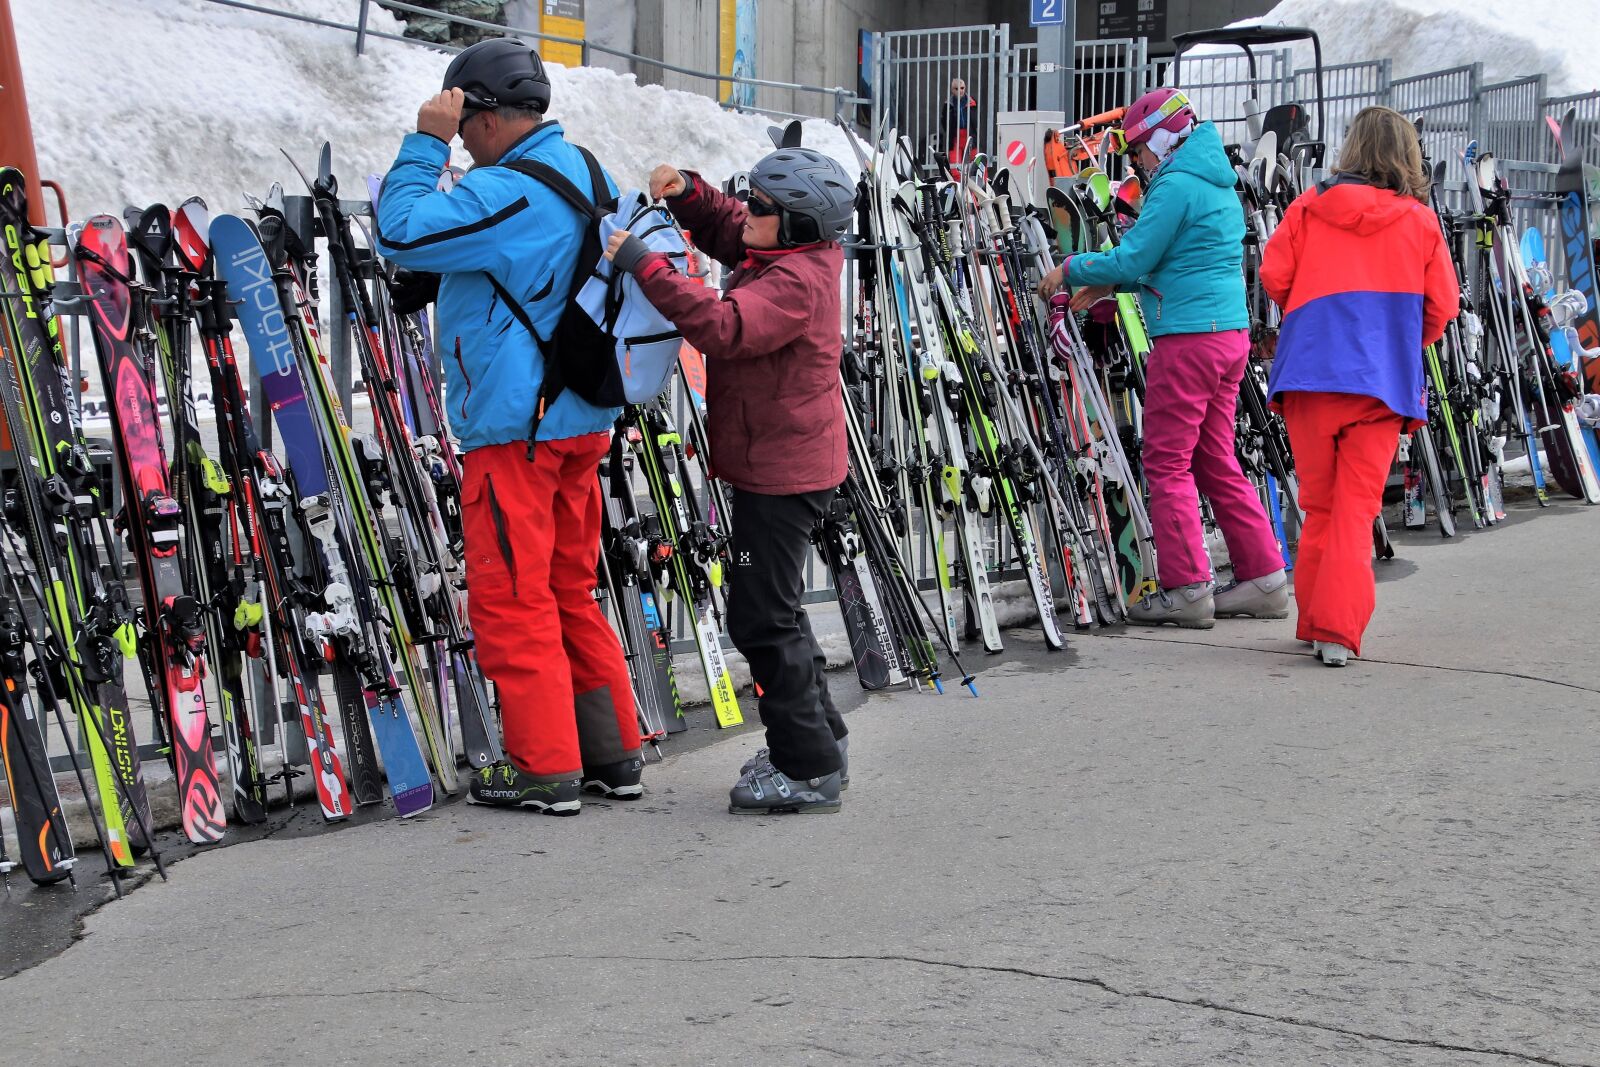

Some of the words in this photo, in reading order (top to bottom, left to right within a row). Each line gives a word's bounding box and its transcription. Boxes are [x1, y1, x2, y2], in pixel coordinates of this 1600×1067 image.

[1042, 0, 1056, 17] 2
[5, 224, 37, 319] HEAD
[231, 245, 296, 377] stöckli
[1031, 541, 1053, 607] NOMAD
[707, 631, 730, 703] REBELS
[877, 617, 898, 669] REBELS
[109, 706, 135, 786] INSTINCT
[348, 704, 363, 765] STÖCKLI
[192, 782, 226, 840] K2
[393, 782, 408, 794] 159
